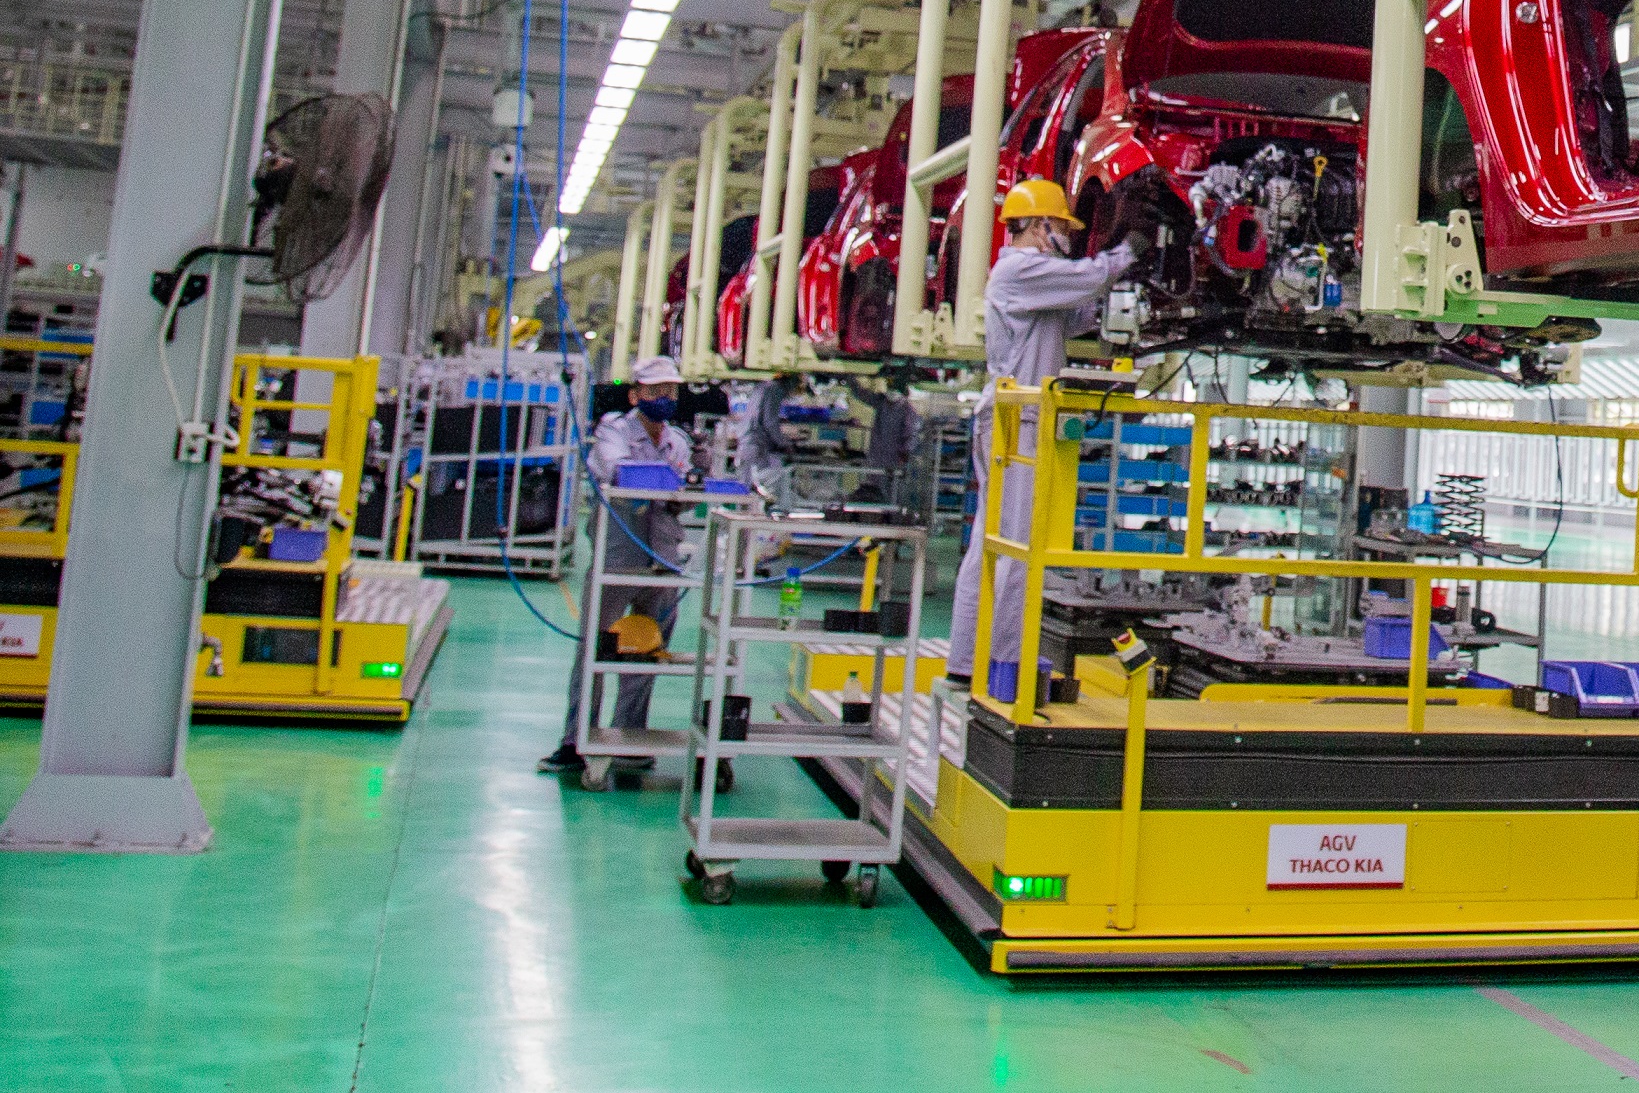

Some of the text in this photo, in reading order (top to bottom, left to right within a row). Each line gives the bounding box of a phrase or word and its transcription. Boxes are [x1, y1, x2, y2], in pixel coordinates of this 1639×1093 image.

[1319, 835, 1357, 851] AGV
[1289, 859, 1384, 873] THACO KIA
